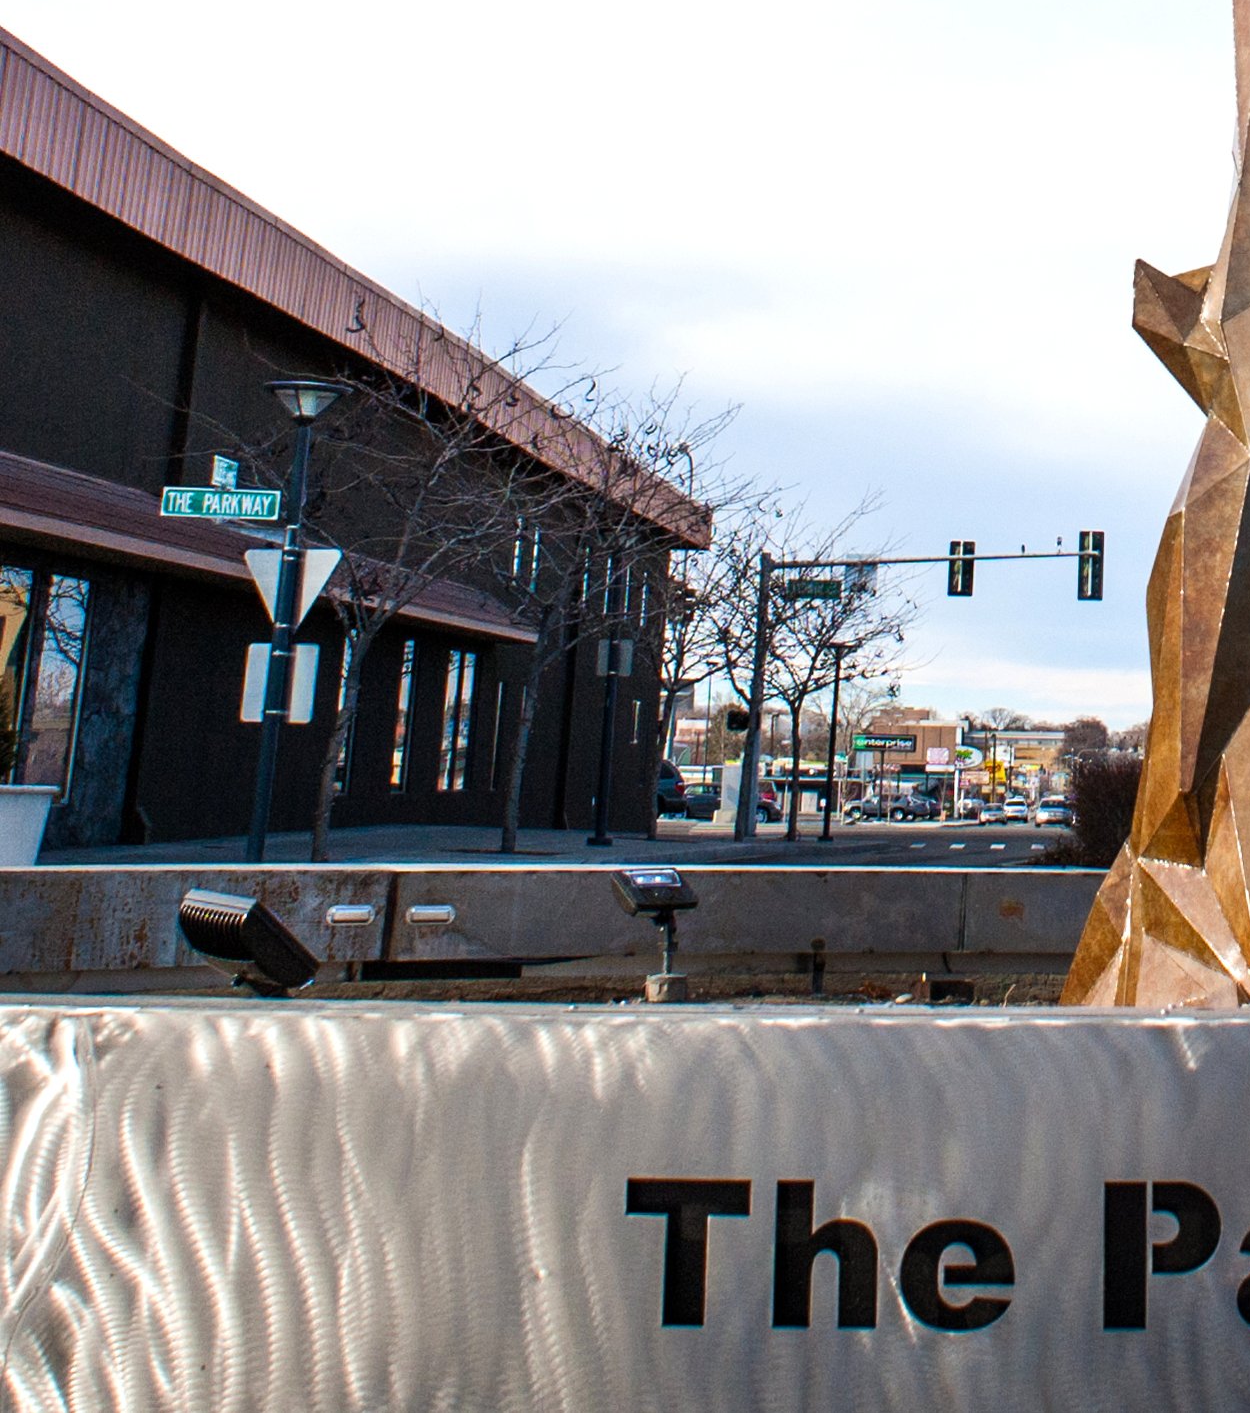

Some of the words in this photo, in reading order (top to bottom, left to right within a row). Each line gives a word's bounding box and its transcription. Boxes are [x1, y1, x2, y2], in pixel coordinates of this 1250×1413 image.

[167, 491, 194, 513] THE
[202, 492, 273, 516] PARKWAY
[624, 1177, 1017, 1333] The
